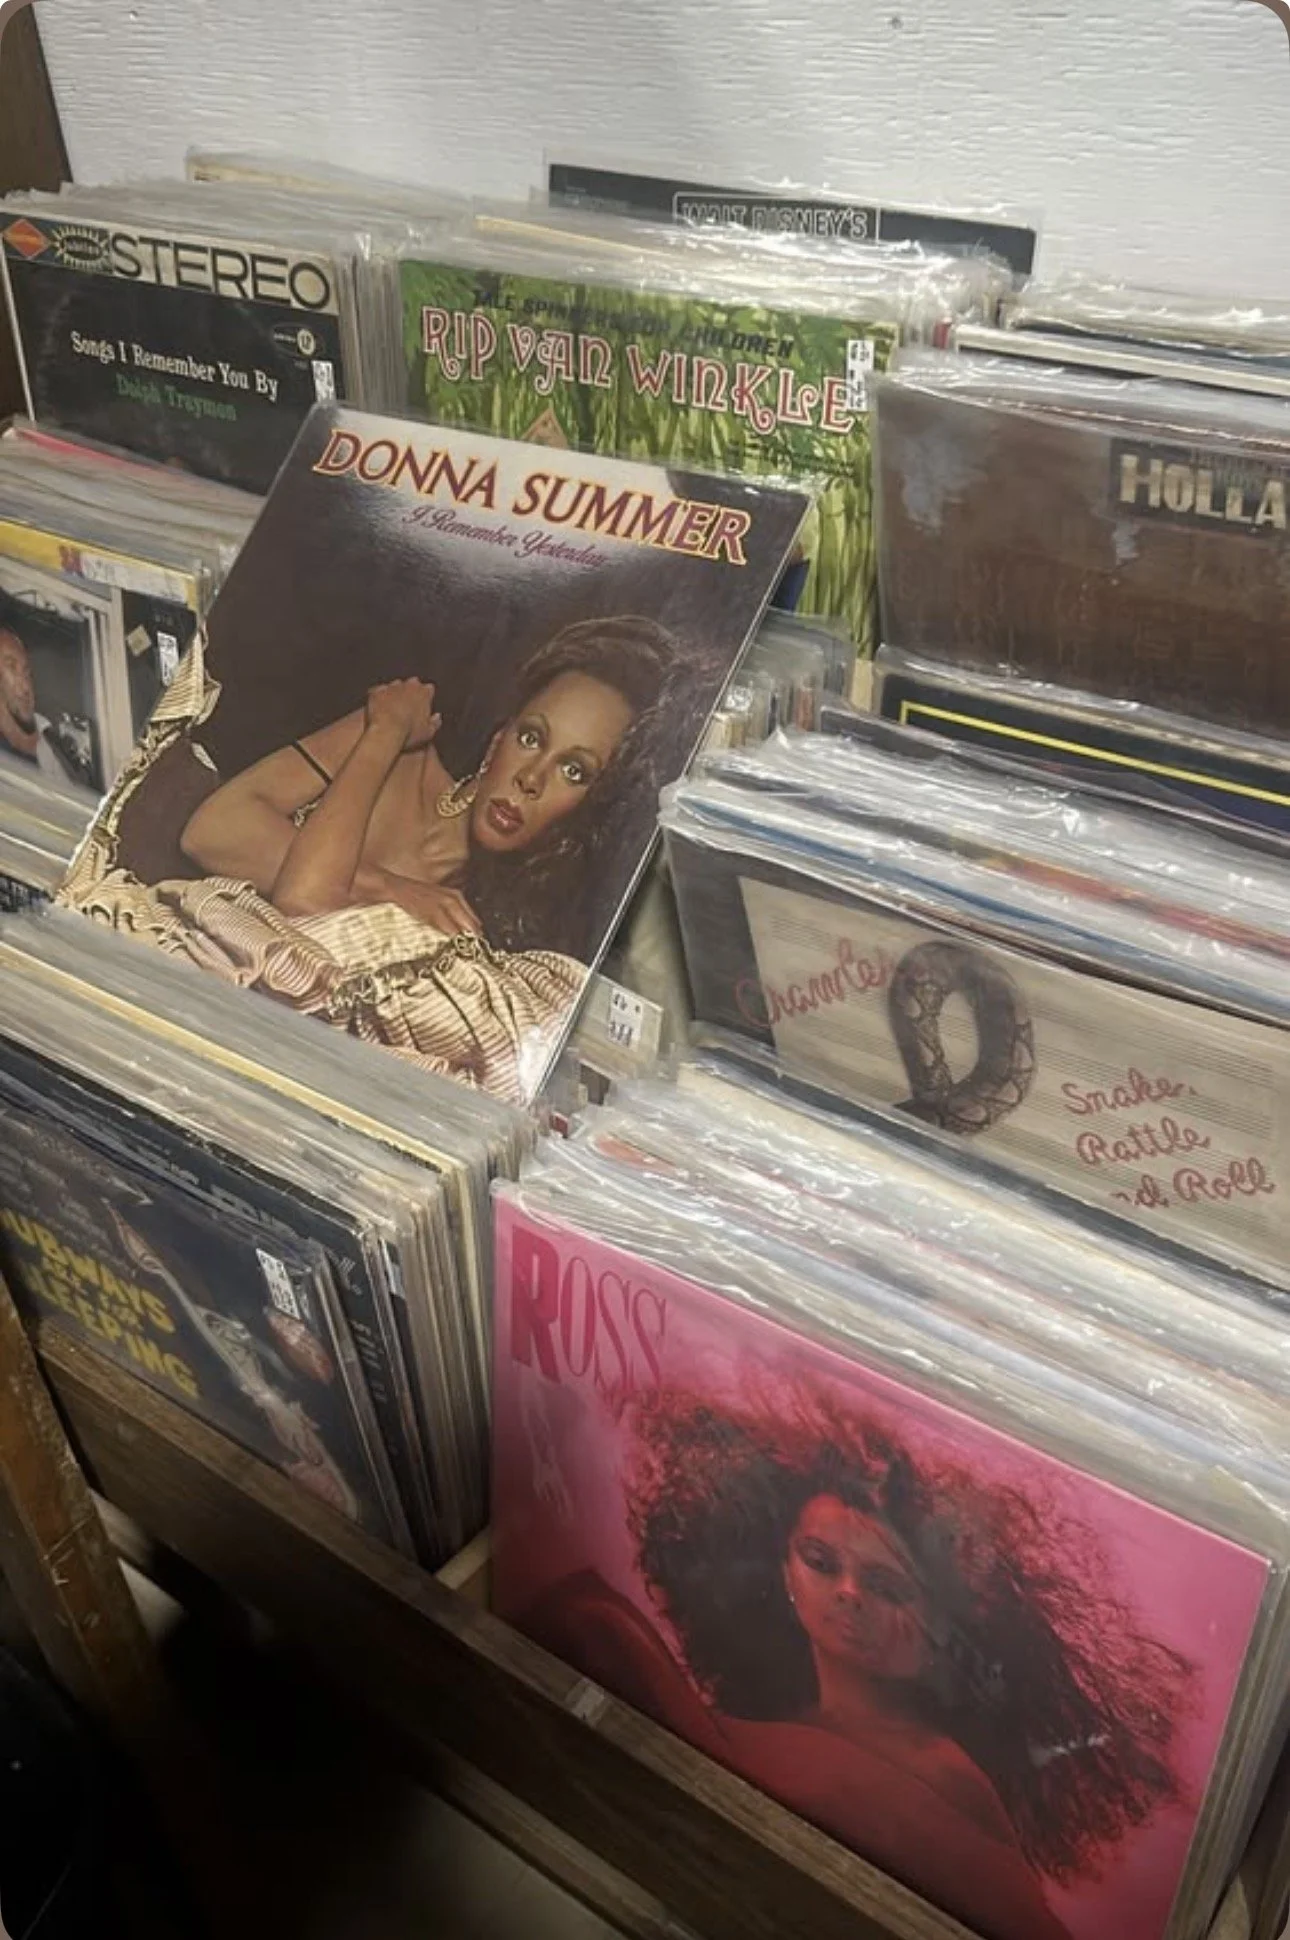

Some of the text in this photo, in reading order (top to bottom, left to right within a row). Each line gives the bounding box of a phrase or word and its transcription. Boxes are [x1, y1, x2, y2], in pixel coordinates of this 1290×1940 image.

[751, 206, 868, 240] DISNEY'S
[111, 232, 331, 310] STEREO
[70, 330, 116, 365] Songs
[132, 343, 216, 383] Remember
[216, 360, 250, 390] You
[255, 368, 280, 404] By
[422, 305, 498, 381] RIP
[506, 323, 613, 397] VAN
[625, 343, 856, 436] WINKLE
[311, 428, 753, 566] DONNA SUMMER
[1119, 453, 1288, 530] HOLLA
[424, 506, 518, 548] Remember
[514, 529, 608, 568] Yesterday
[1076, 1116, 1211, 1166] Rattle
[1173, 1157, 1277, 1203] Roll
[511, 1224, 667, 1398] ROSS
